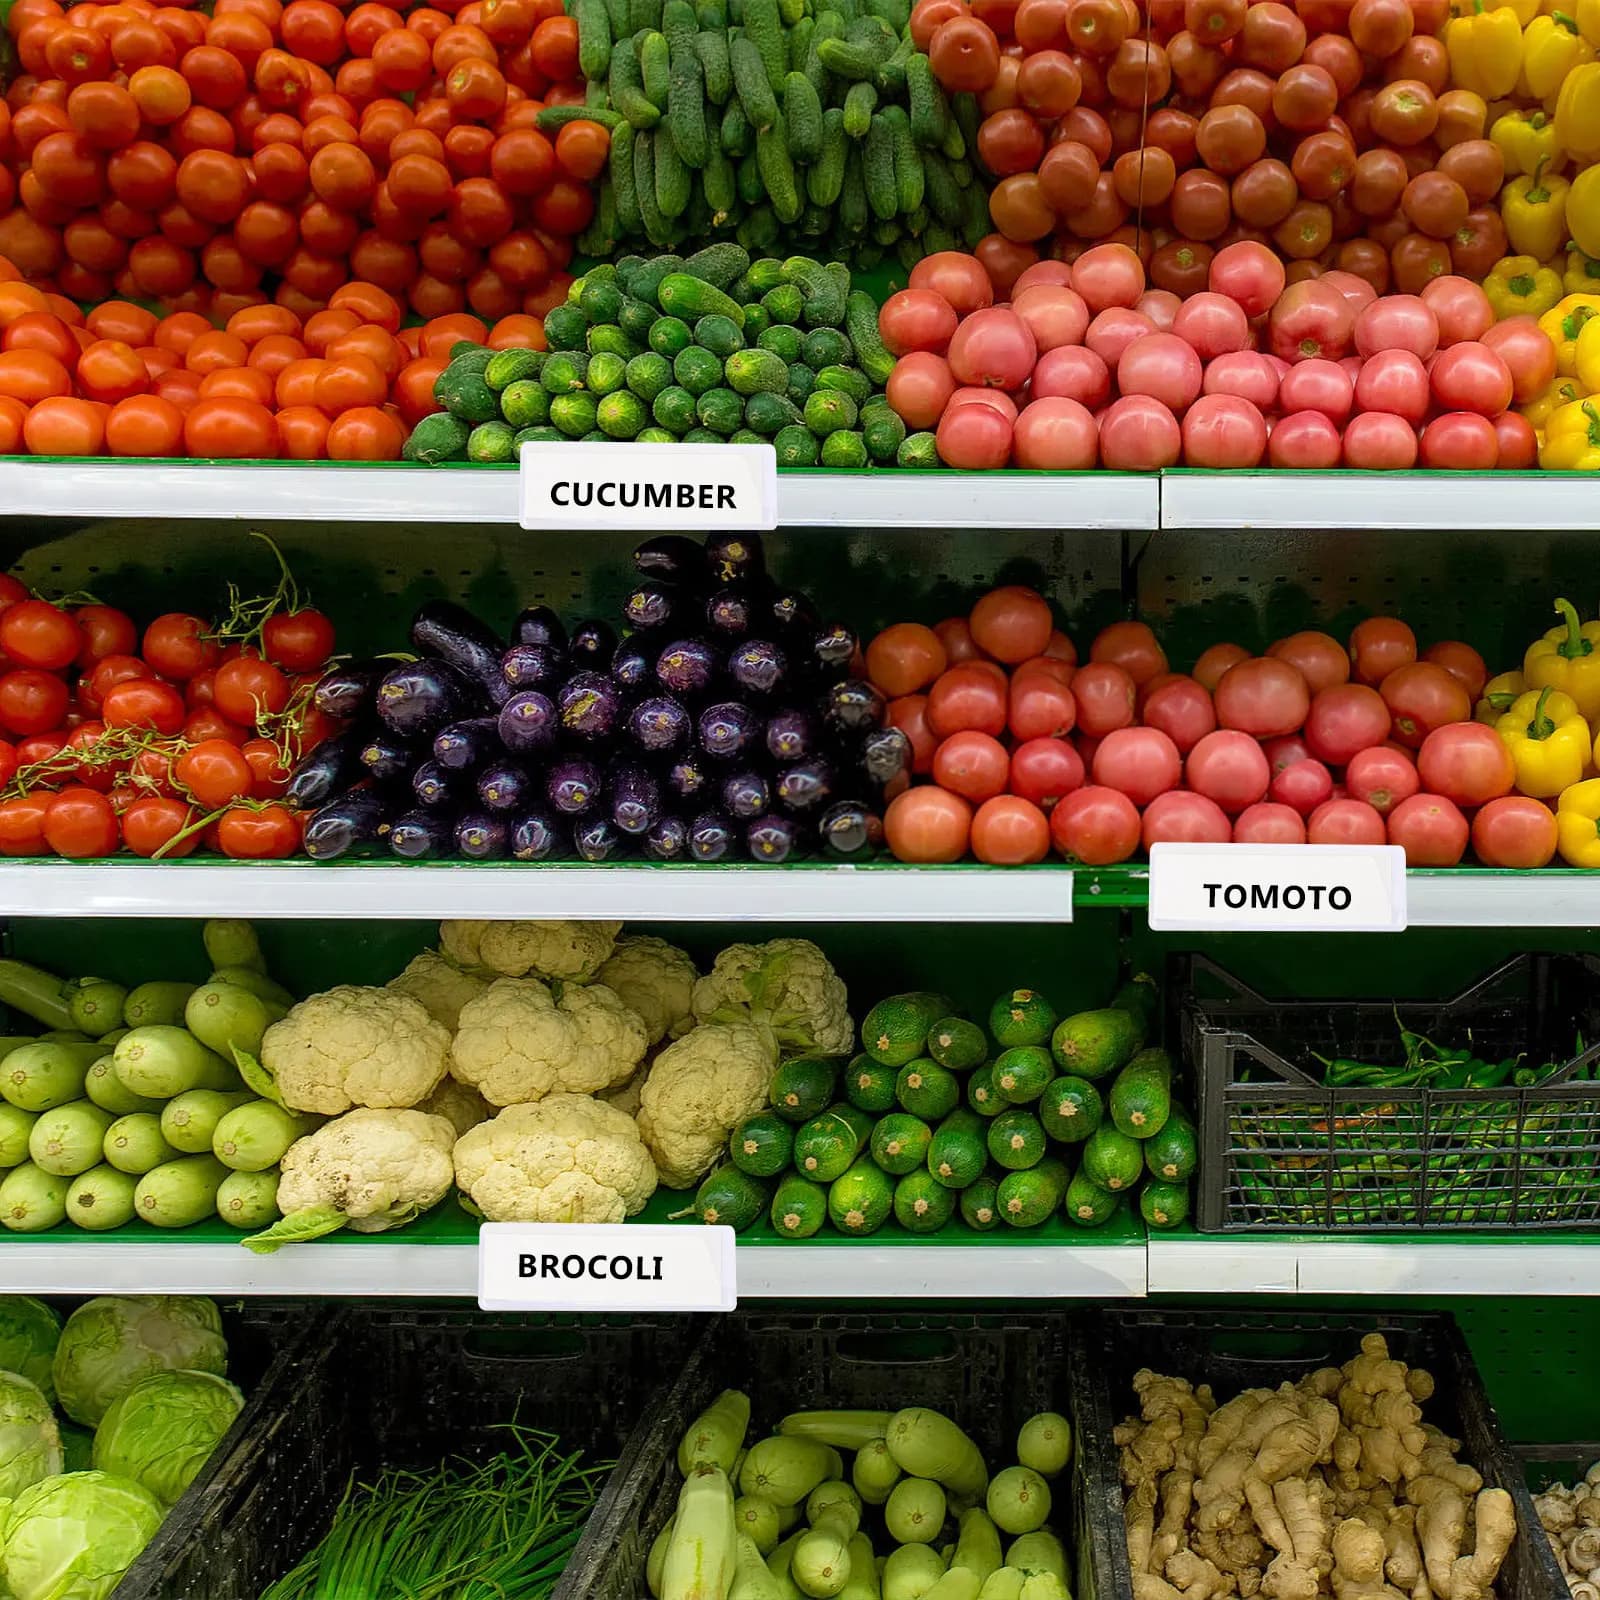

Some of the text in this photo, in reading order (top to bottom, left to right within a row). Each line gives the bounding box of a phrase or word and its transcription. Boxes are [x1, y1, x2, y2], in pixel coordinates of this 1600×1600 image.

[550, 481, 737, 509] CUCUMBER
[1203, 883, 1352, 911] TOMOTO
[518, 1253, 663, 1281] BROCOLI
